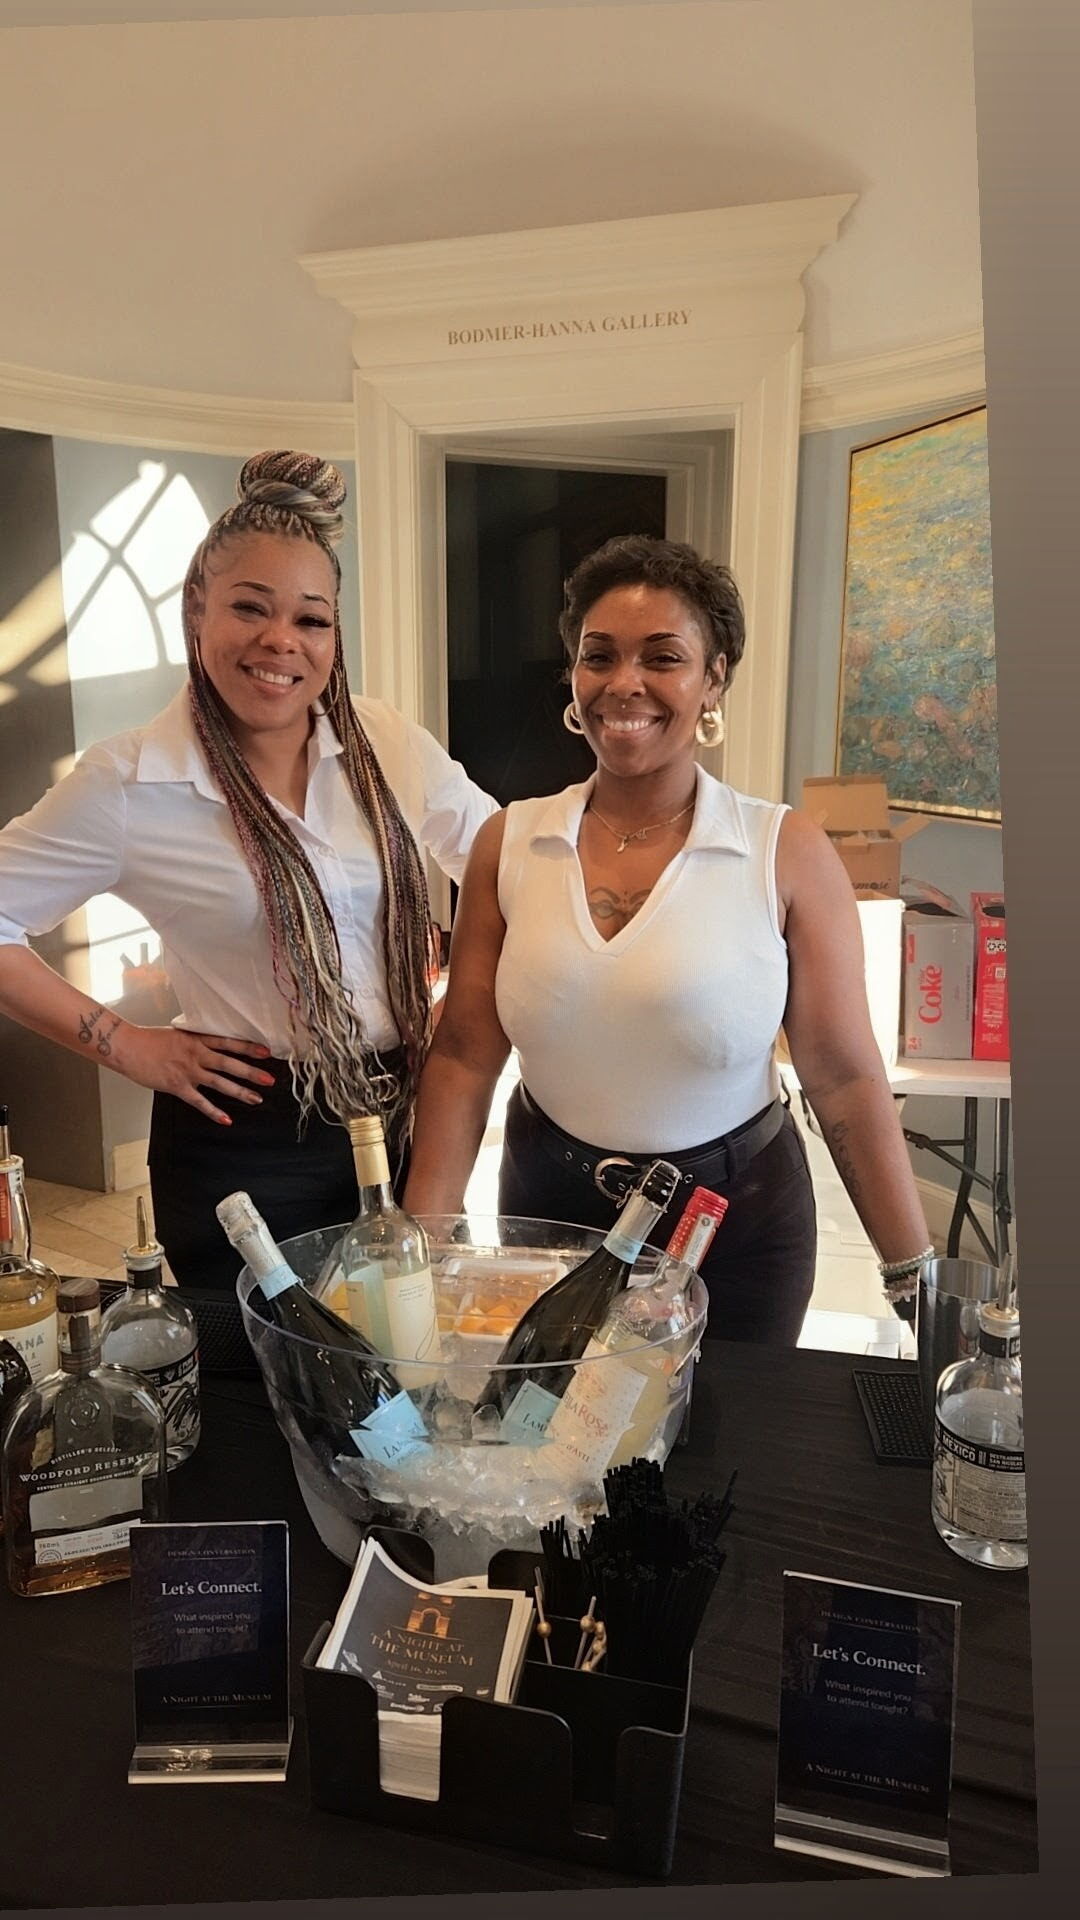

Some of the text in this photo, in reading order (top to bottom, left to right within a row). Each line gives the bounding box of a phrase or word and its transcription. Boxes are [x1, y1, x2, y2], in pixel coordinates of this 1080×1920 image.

[448, 309, 692, 346] BODMER-HANNA GALLERY
[918, 964, 943, 1024] Coke
[908, 1037, 918, 1051] 24
[942, 1433, 976, 1462] MEXICO
[19, 1450, 158, 1482] WOODFORD RESERVE
[161, 1581, 262, 1596] Let's Connect.
[174, 1611, 250, 1624] What inspired you
[176, 1624, 248, 1636] to attend tonight?
[371, 1633, 475, 1667] THE MUSEUM
[383, 1629, 466, 1653] A NIGHT AT
[812, 1643, 927, 1676] Let's Connect.
[161, 1696, 168, 1704] A
[231, 1693, 272, 1702] MUSEUM
[824, 1679, 912, 1704] What inspired you
[826, 1694, 910, 1716] to attend tonight?
[805, 1763, 813, 1771] A
[815, 1764, 848, 1778] NIGHT
[884, 1777, 930, 1793] MUSEUM
